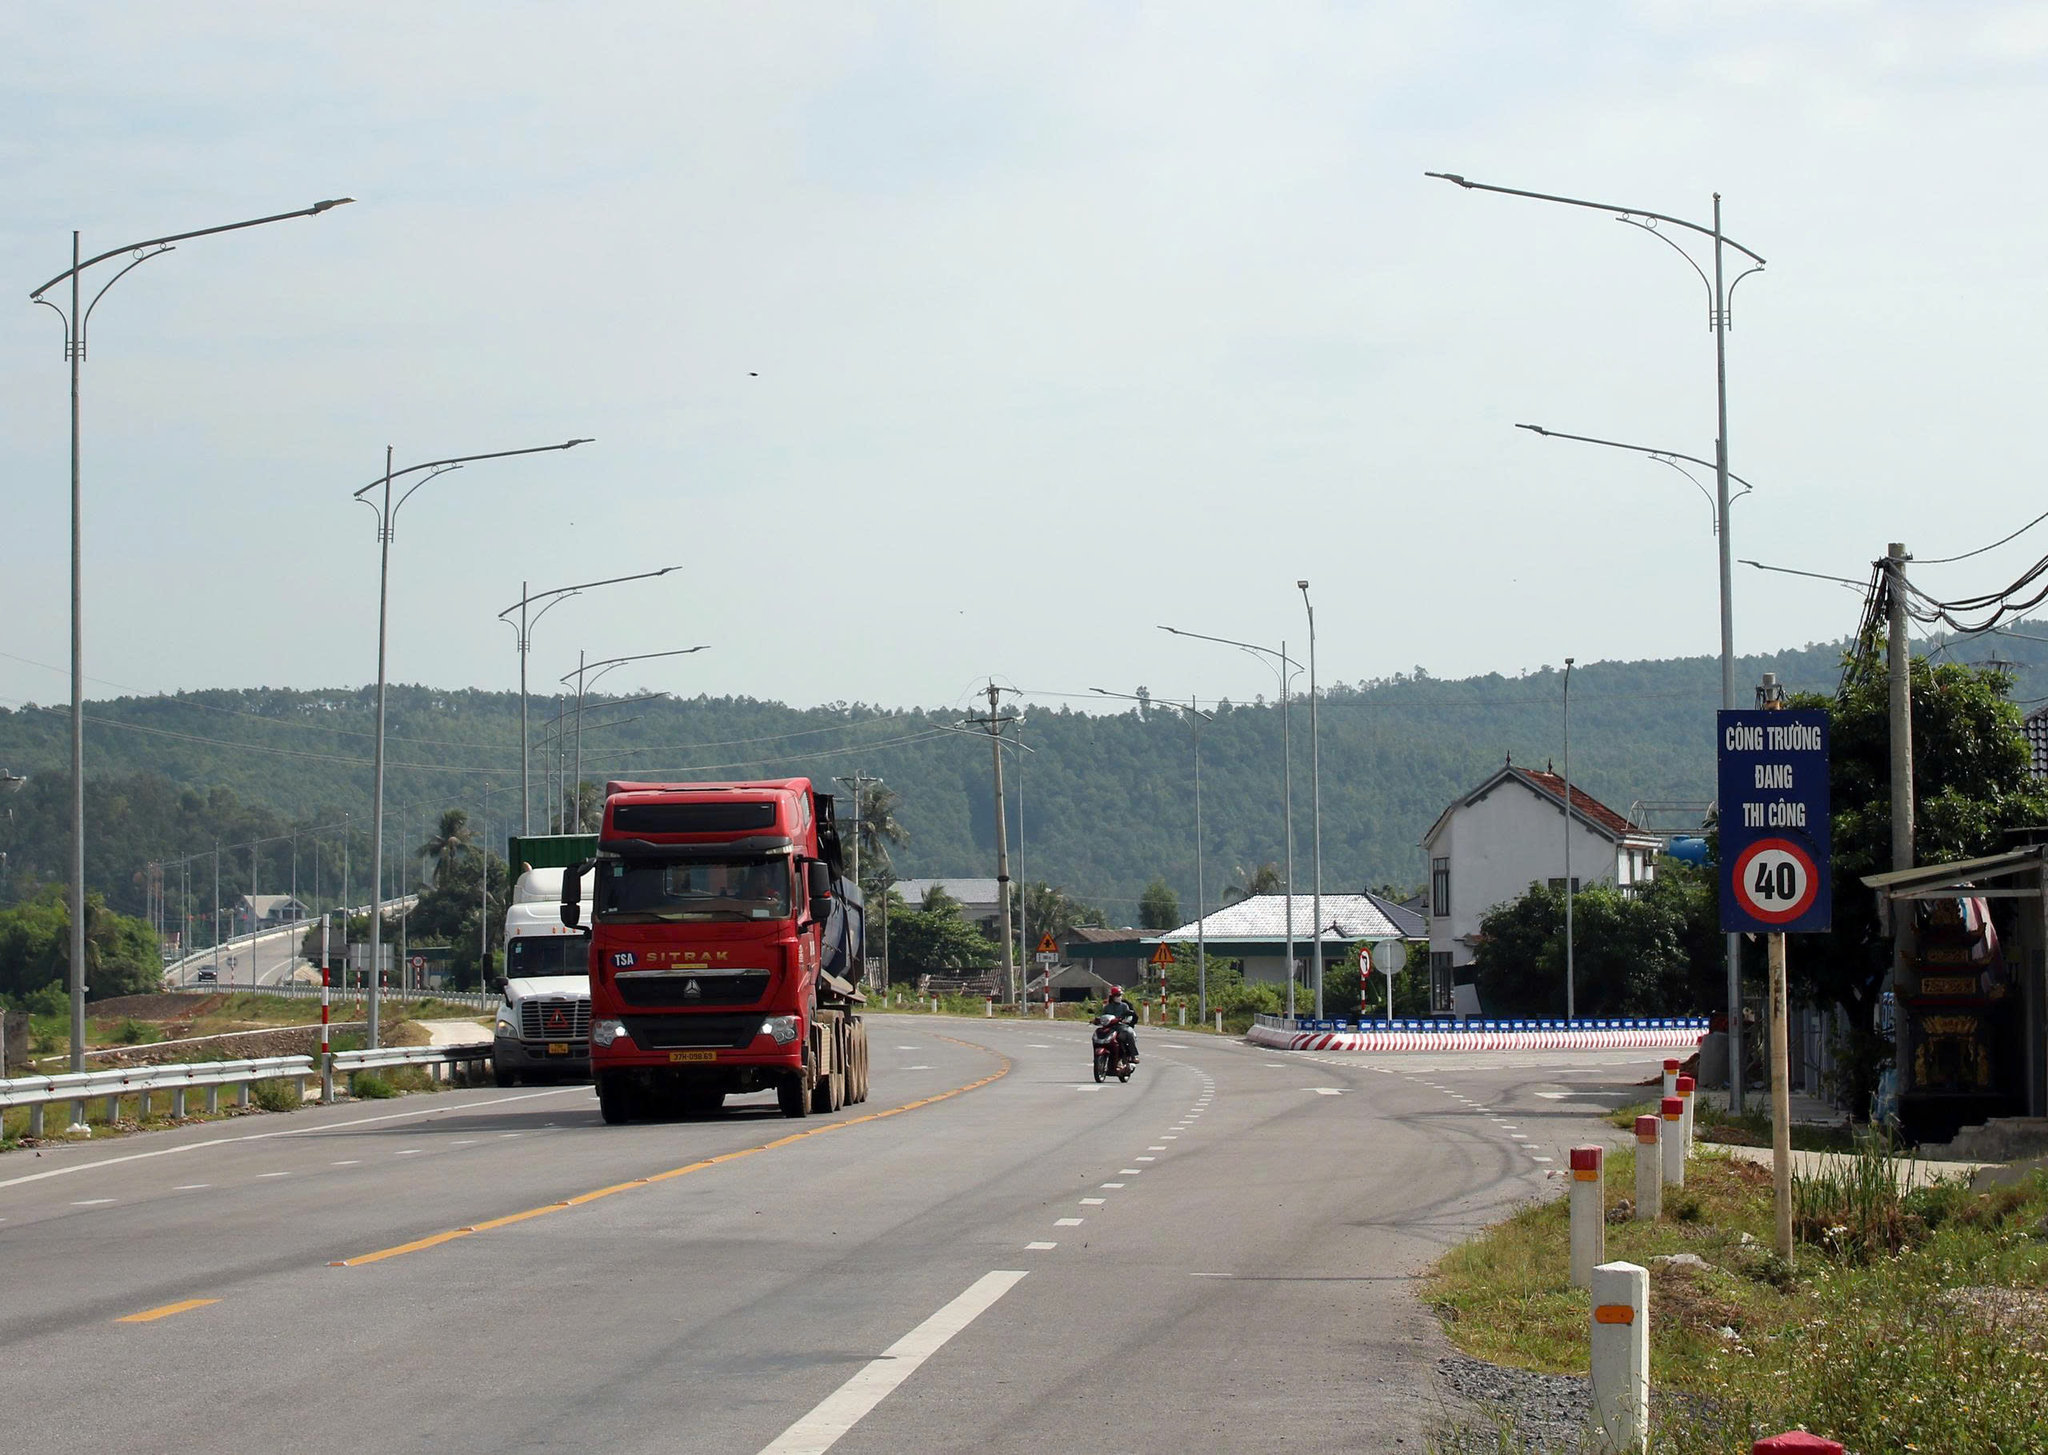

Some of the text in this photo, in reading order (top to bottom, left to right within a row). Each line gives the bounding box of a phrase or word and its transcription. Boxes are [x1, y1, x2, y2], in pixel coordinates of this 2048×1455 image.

[1726, 720, 1821, 751] CÔNG TRƯỜNG
[1755, 764, 1793, 789] ĐANG
[1743, 798, 1806, 827] THI CÔNG
[1755, 862, 1796, 900] 40
[614, 953, 634, 966] TSA
[646, 951, 729, 961] SITRAK
